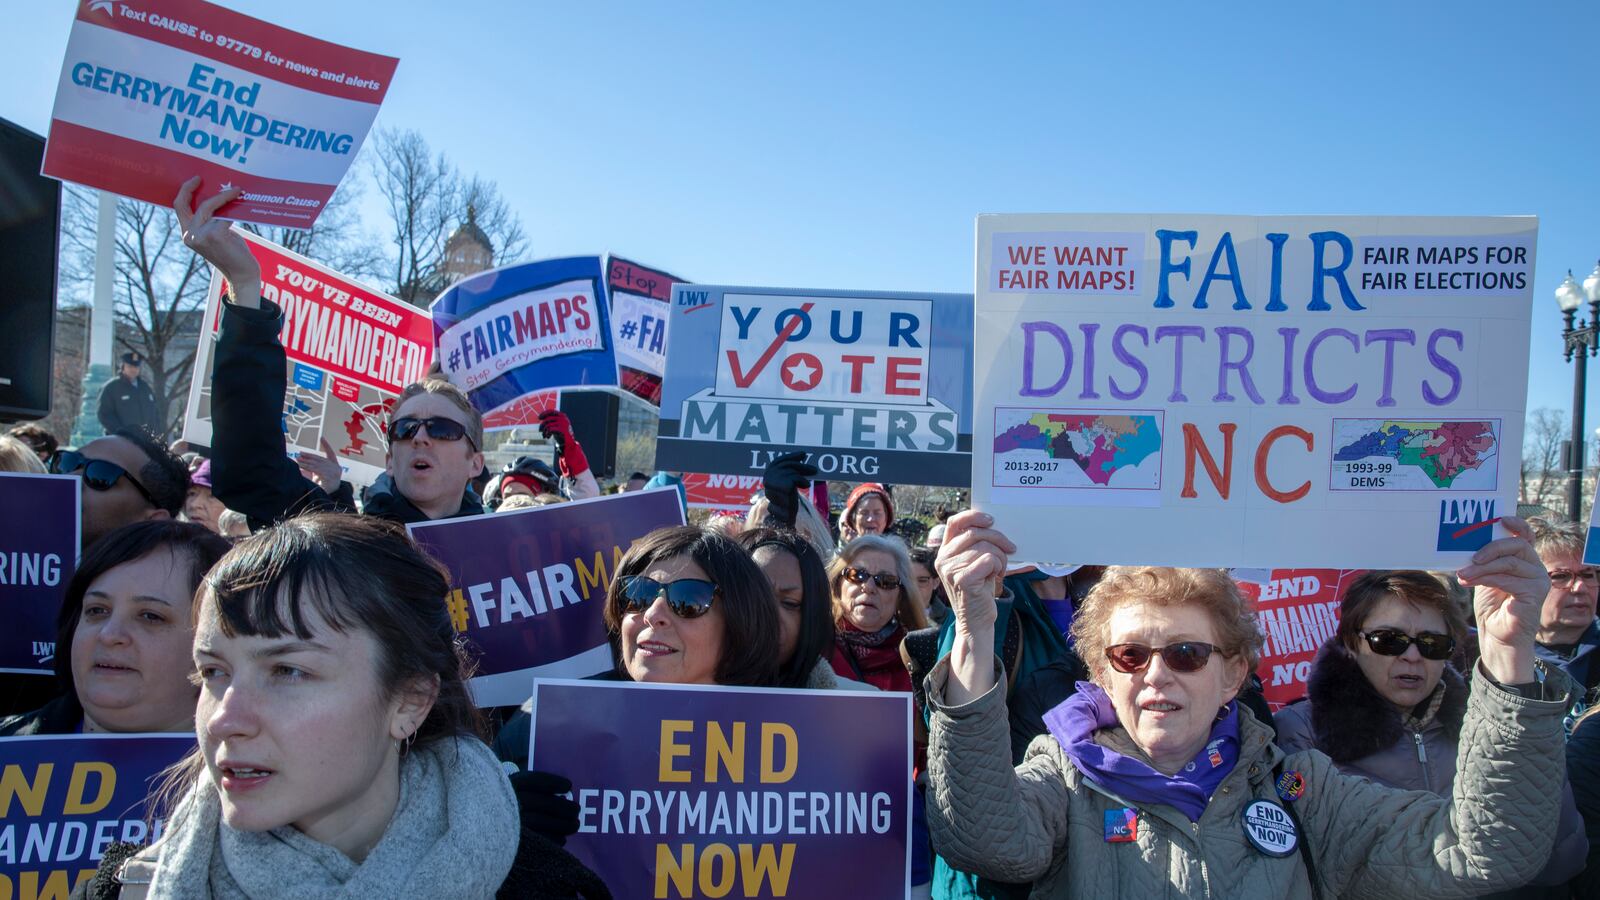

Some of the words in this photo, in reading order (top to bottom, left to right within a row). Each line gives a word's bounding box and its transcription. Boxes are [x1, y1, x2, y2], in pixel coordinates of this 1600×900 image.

[120, 4, 147, 22] Text
[148, 13, 198, 38] CAUSE
[200, 30, 214, 43] to
[216, 35, 262, 59] 97779
[264, 51, 284, 66] for
[285, 60, 319, 77] news
[320, 70, 345, 84] and
[345, 75, 380, 91] alerts
[187, 62, 262, 108] End
[71, 62, 353, 156] GERRYMANDERING
[159, 114, 253, 165] Now!
[285, 195, 320, 208] Cause
[1008, 246, 1046, 265] WE
[1053, 246, 1128, 266] WANT
[1152, 229, 1367, 311] FAIR
[1364, 247, 1410, 265] FAIR
[1416, 246, 1479, 265] MAPS
[1485, 246, 1527, 265] FOR
[275, 264, 351, 306] YOU'VE
[349, 297, 403, 328] BEEN
[612, 266, 657, 297] Stop
[998, 269, 1049, 289] FAIR
[1056, 270, 1135, 290] MAPS!
[1361, 272, 1407, 290] FAIR
[1414, 271, 1527, 290] ELECTIONS
[678, 290, 709, 306] LWV
[448, 295, 591, 373] #FAIRMAPS
[620, 314, 667, 357] #FA
[730, 306, 922, 348] YOUR
[726, 340, 922, 397] VOTE
[1018, 321, 1464, 407] DISTRICTS
[683, 400, 955, 452] MATTERS
[1004, 461, 1059, 473] 2013-2017
[1019, 475, 1043, 486] GOP
[1181, 422, 1314, 503] NC
[1345, 463, 1392, 474] 1993-99
[1350, 476, 1385, 488] DEMS
[1443, 499, 1492, 525] LWV
[447, 545, 627, 632] #FAIRM
[1258, 576, 1320, 602] END
[658, 719, 799, 784] END
[564, 788, 892, 835] ERRYMANDERING
[1248, 816, 1294, 833] GERRYMANDERING
[1256, 805, 1284, 822] END
[1113, 826, 1127, 834] NC
[1257, 827, 1287, 846] NOW
[654, 843, 797, 899] NOW
